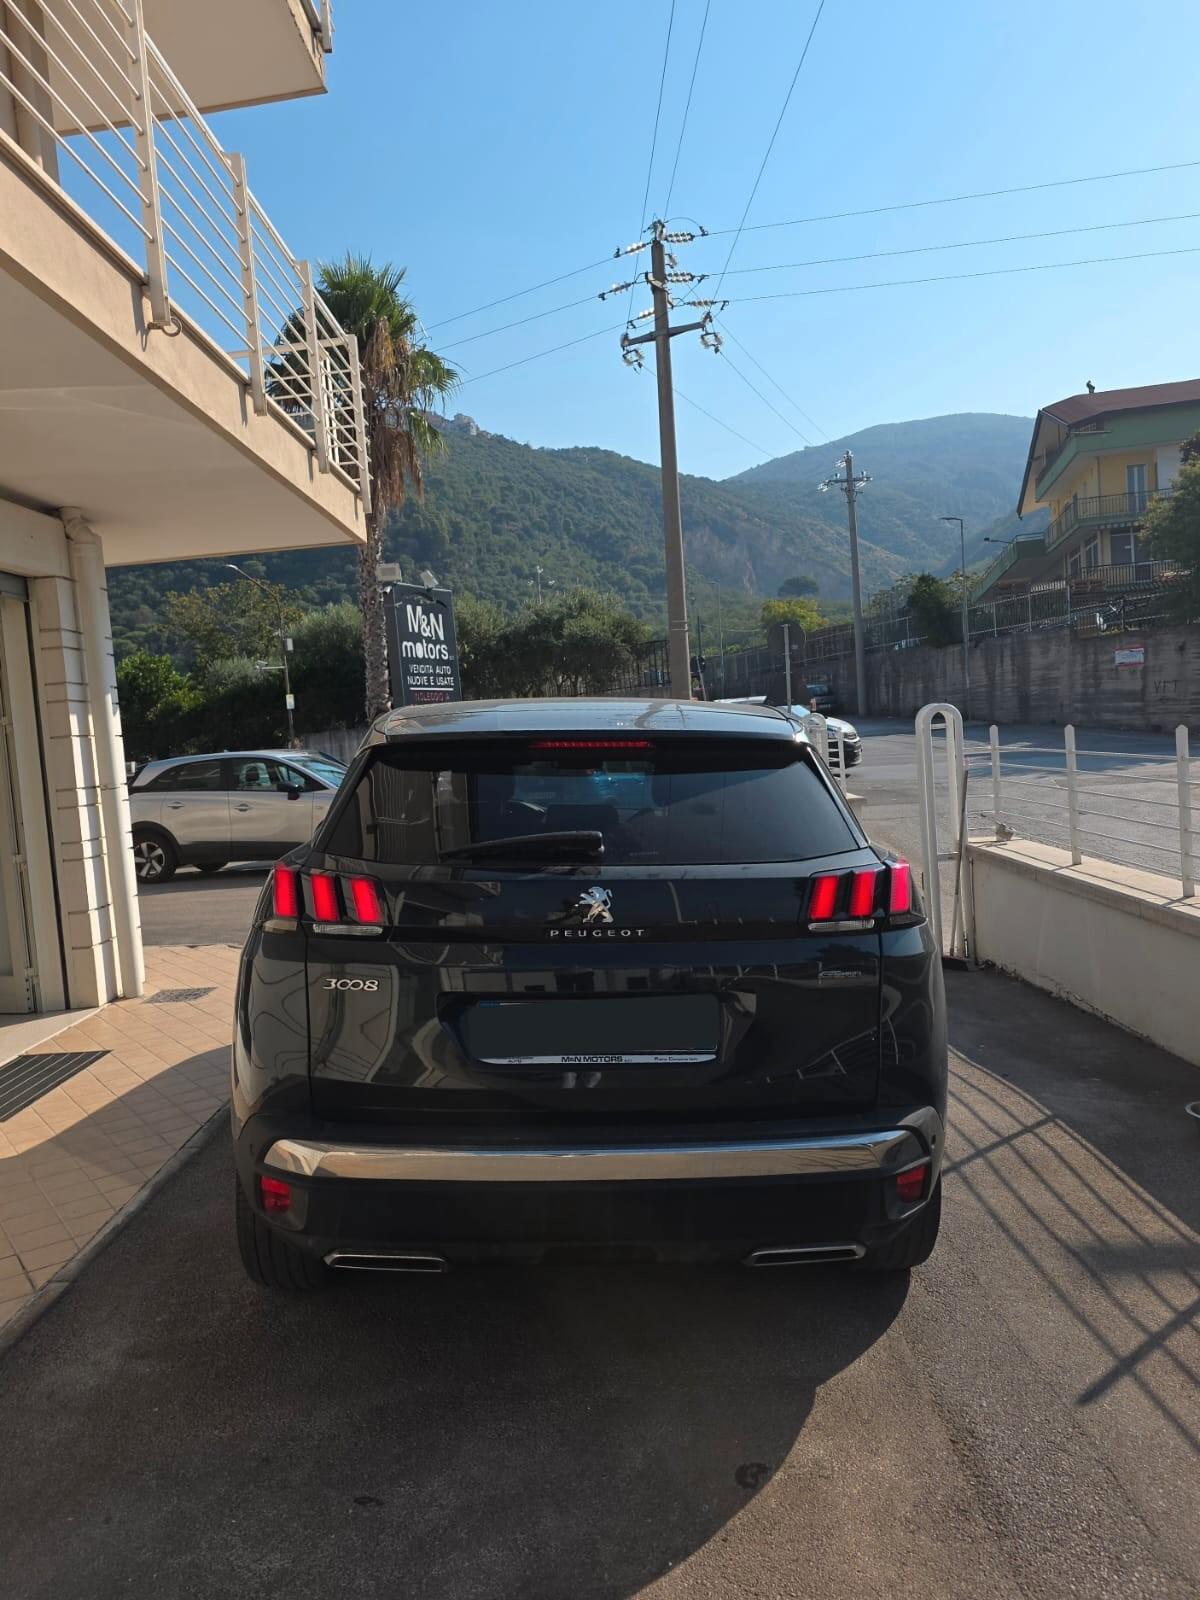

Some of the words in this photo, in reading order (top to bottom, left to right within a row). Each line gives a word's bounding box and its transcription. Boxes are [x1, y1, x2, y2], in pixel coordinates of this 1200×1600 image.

[406, 604, 445, 641] M&N
[402, 639, 449, 660] motors
[409, 664, 434, 674] VENDITA
[435, 665, 452, 675] AUTO
[407, 676, 428, 685] NUOVE
[430, 676, 435, 686] E
[436, 677, 455, 686] USATE
[549, 929, 645, 937] PEUGEOT
[322, 978, 379, 991] 3008
[583, 1055, 623, 1063] MOTORS
